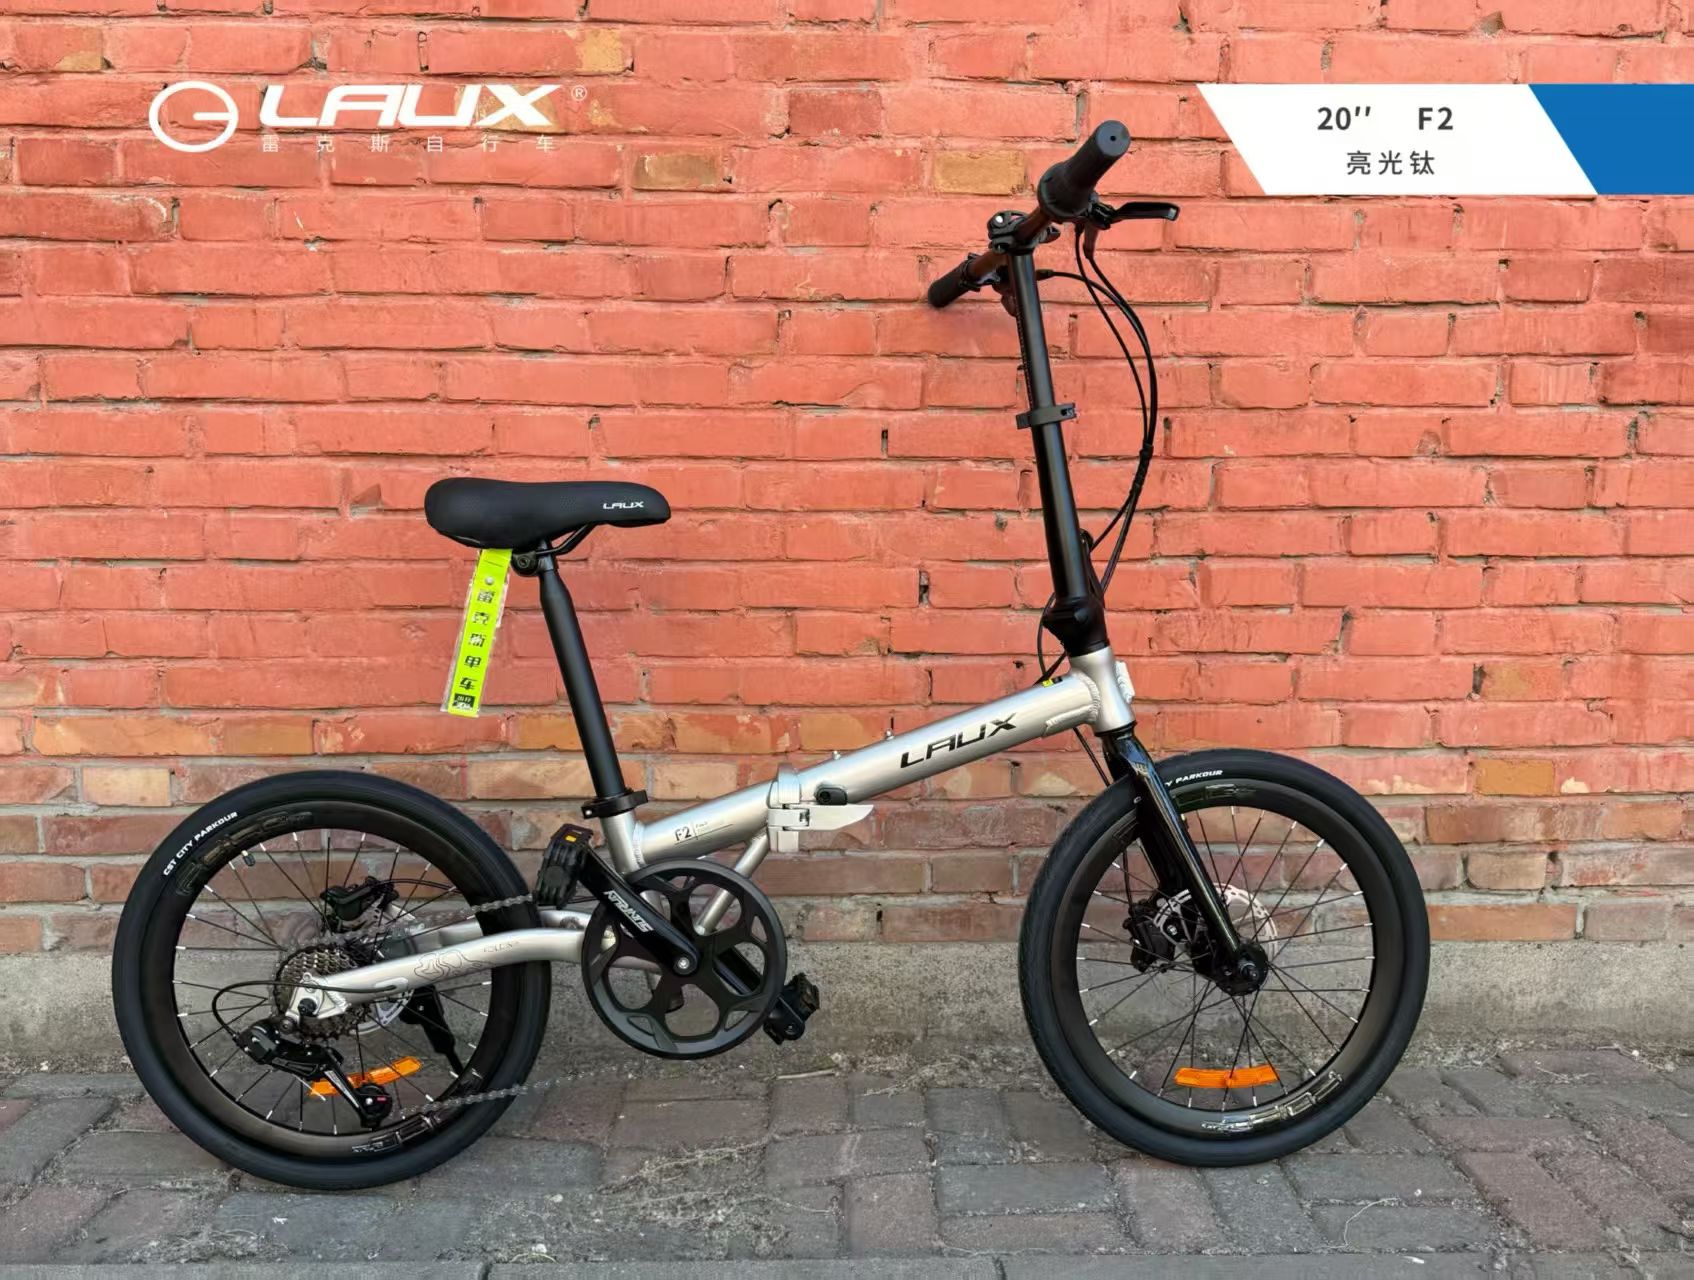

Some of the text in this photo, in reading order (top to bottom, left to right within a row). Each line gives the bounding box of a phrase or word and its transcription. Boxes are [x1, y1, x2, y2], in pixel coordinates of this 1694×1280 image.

[602, 500, 644, 510] LAUX
[900, 712, 1017, 769] LAUX
[1175, 769, 1224, 784] PARKOUR
[674, 826, 692, 842] F2
[162, 860, 177, 876] CST
[176, 839, 194, 859] CITY
[194, 811, 239, 841] PARKOUR
